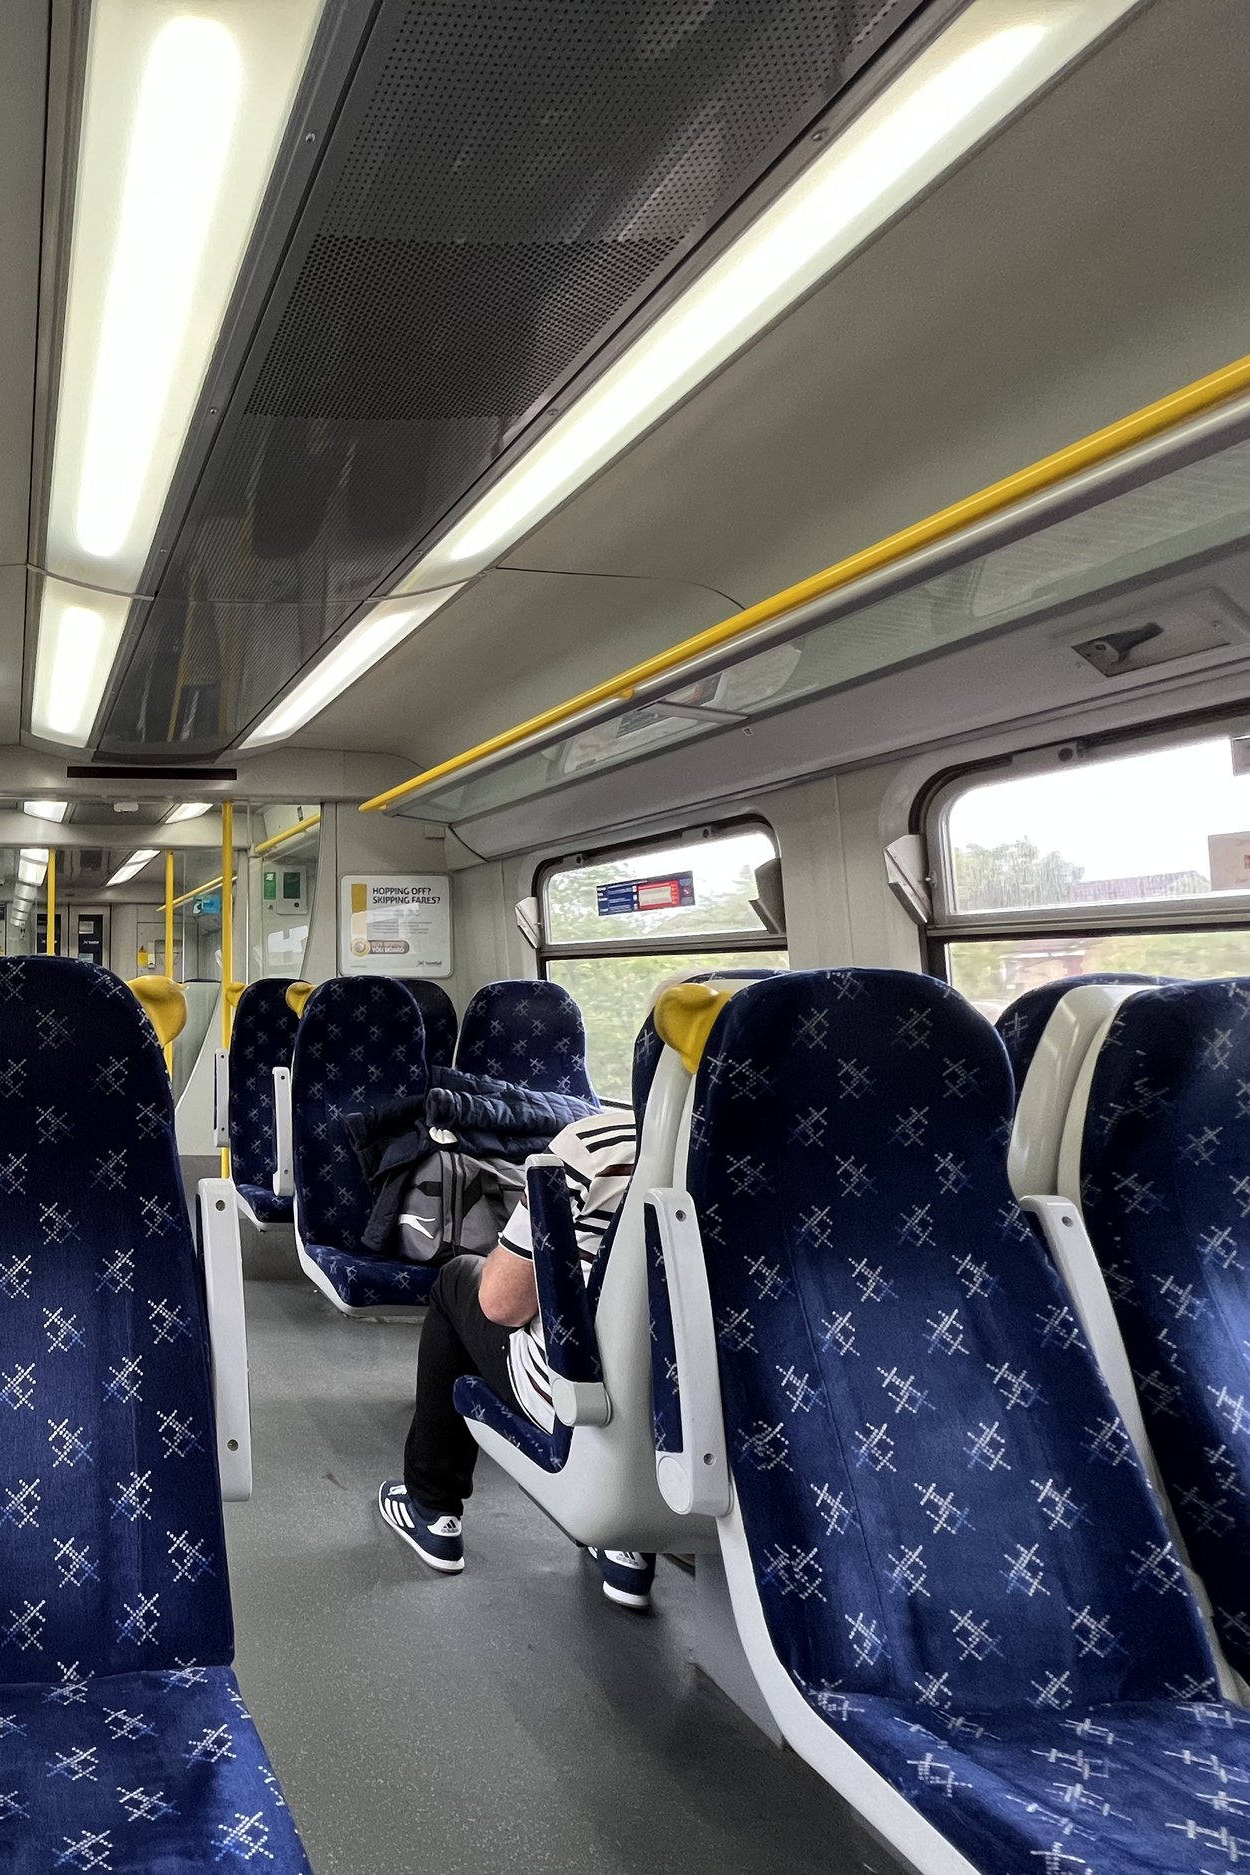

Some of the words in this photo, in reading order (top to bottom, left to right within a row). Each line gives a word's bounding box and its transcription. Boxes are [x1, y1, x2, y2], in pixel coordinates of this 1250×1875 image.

[372, 887, 410, 895] HOPPING
[411, 887, 431, 895] OFF?
[372, 896, 410, 904] SKIPPING
[411, 896, 441, 905] FARES?
